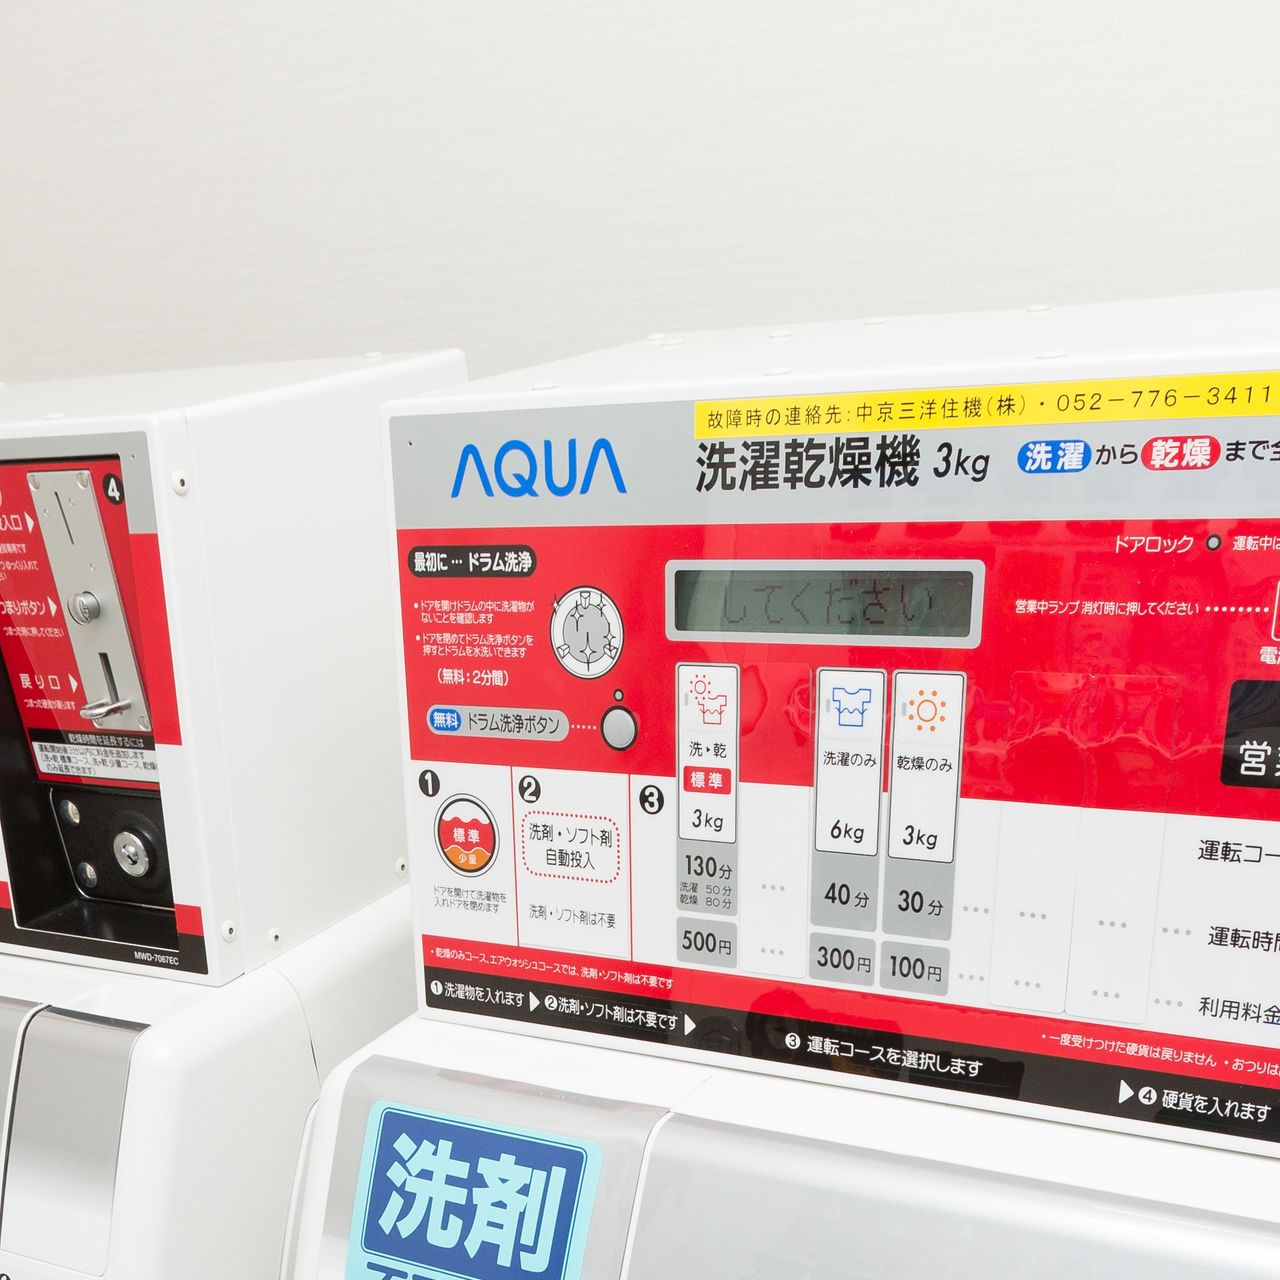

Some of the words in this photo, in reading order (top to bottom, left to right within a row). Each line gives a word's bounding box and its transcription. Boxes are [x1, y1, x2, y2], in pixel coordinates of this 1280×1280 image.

[450, 437, 627, 498] AQUA
[695, 434, 921, 493] 洗濯乾燥機
[932, 442, 991, 481] 3kg
[1025, 441, 1085, 471] 洗濯
[1095, 444, 1139, 465] から
[1150, 439, 1211, 468] 乾燥
[1115, 535, 1194, 554] ドアロック
[19, 674, 60, 689] 戻り口
[433, 712, 459, 728] 無料
[468, 712, 560, 734] ドラム洗浄ボタン
[823, 750, 877, 768] 洗濯のみ
[896, 755, 953, 773] 乾燥のみ
[690, 771, 723, 789] 標準
[692, 809, 724, 832] 3kg
[830, 819, 865, 844] 6kg
[453, 827, 480, 844] 標準
[529, 823, 613, 848] 洗剤・ソフト剤
[902, 824, 938, 850] 3kg
[546, 848, 595, 870] 自動投入
[682, 930, 732, 956] 500円
[134, 951, 179, 965] MWD-7067EC
[817, 946, 871, 974] 300円
[890, 955, 942, 983] 100円
[807, 1035, 983, 1077] 運転コースを選択します
[1162, 1089, 1272, 1122] 硬貨を入れます
[378, 1132, 567, 1273] 洗剤
